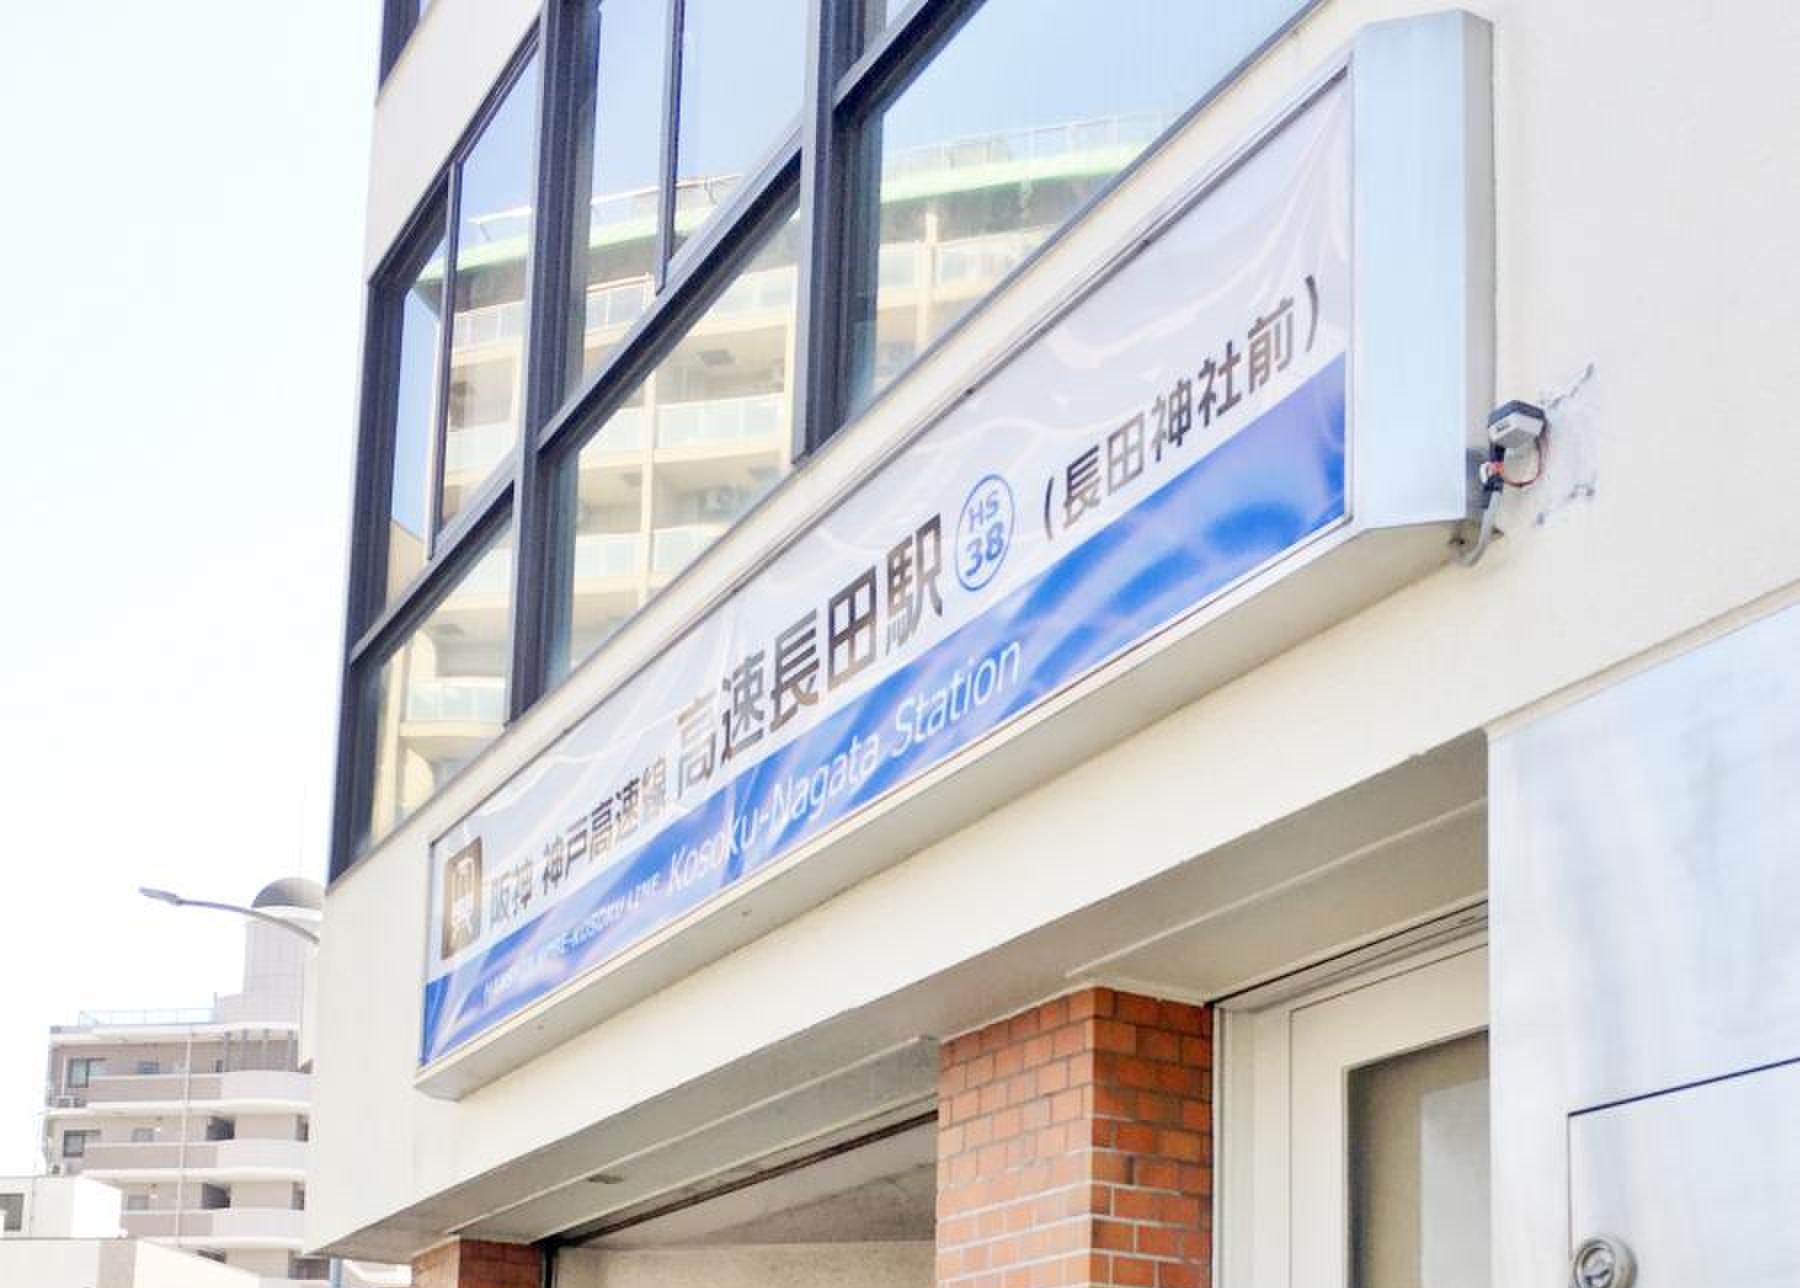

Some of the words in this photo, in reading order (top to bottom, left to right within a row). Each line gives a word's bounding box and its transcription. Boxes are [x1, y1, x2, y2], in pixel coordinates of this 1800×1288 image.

[964, 516, 1004, 578] 38
[967, 489, 999, 530] HS
[677, 512, 943, 798] 高速長田駅
[667, 732, 880, 896] Kosoku-Nagata
[891, 639, 1021, 758] Station
